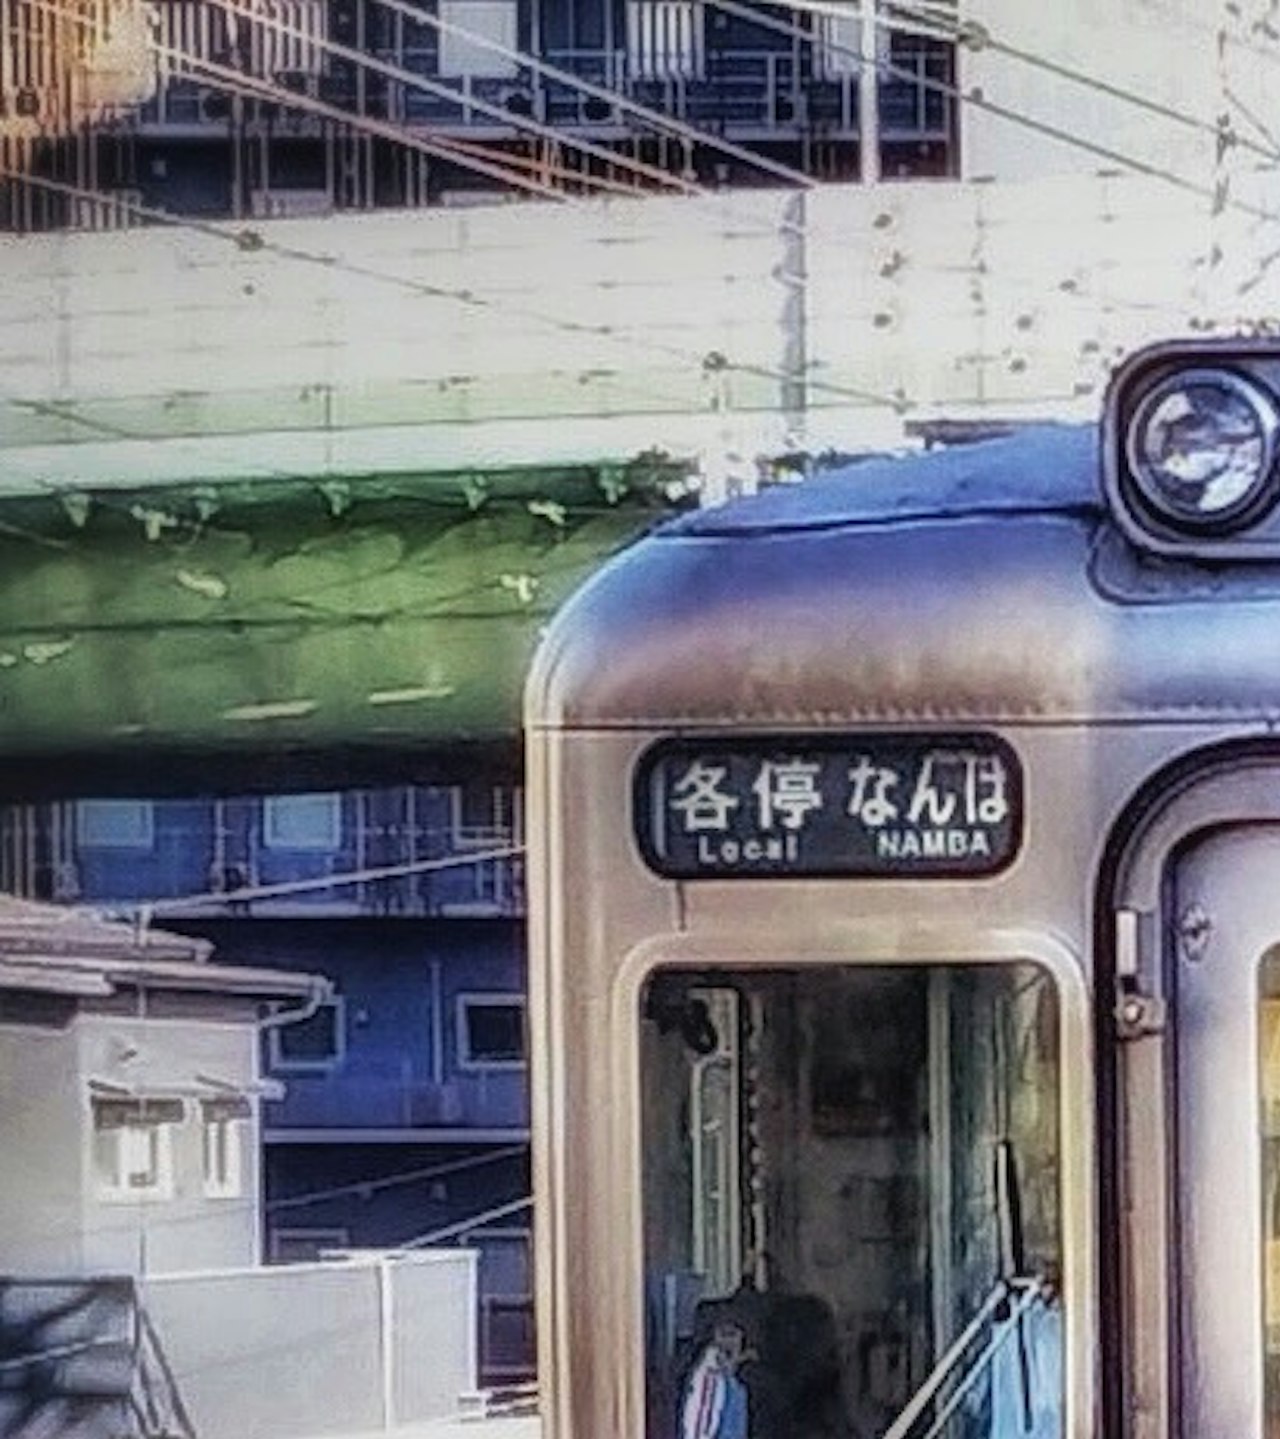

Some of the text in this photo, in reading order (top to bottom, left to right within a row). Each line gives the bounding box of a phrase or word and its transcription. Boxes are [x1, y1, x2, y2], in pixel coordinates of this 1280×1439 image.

[669, 757, 823, 832] 各停
[698, 829, 992, 864] Local NAMBA
